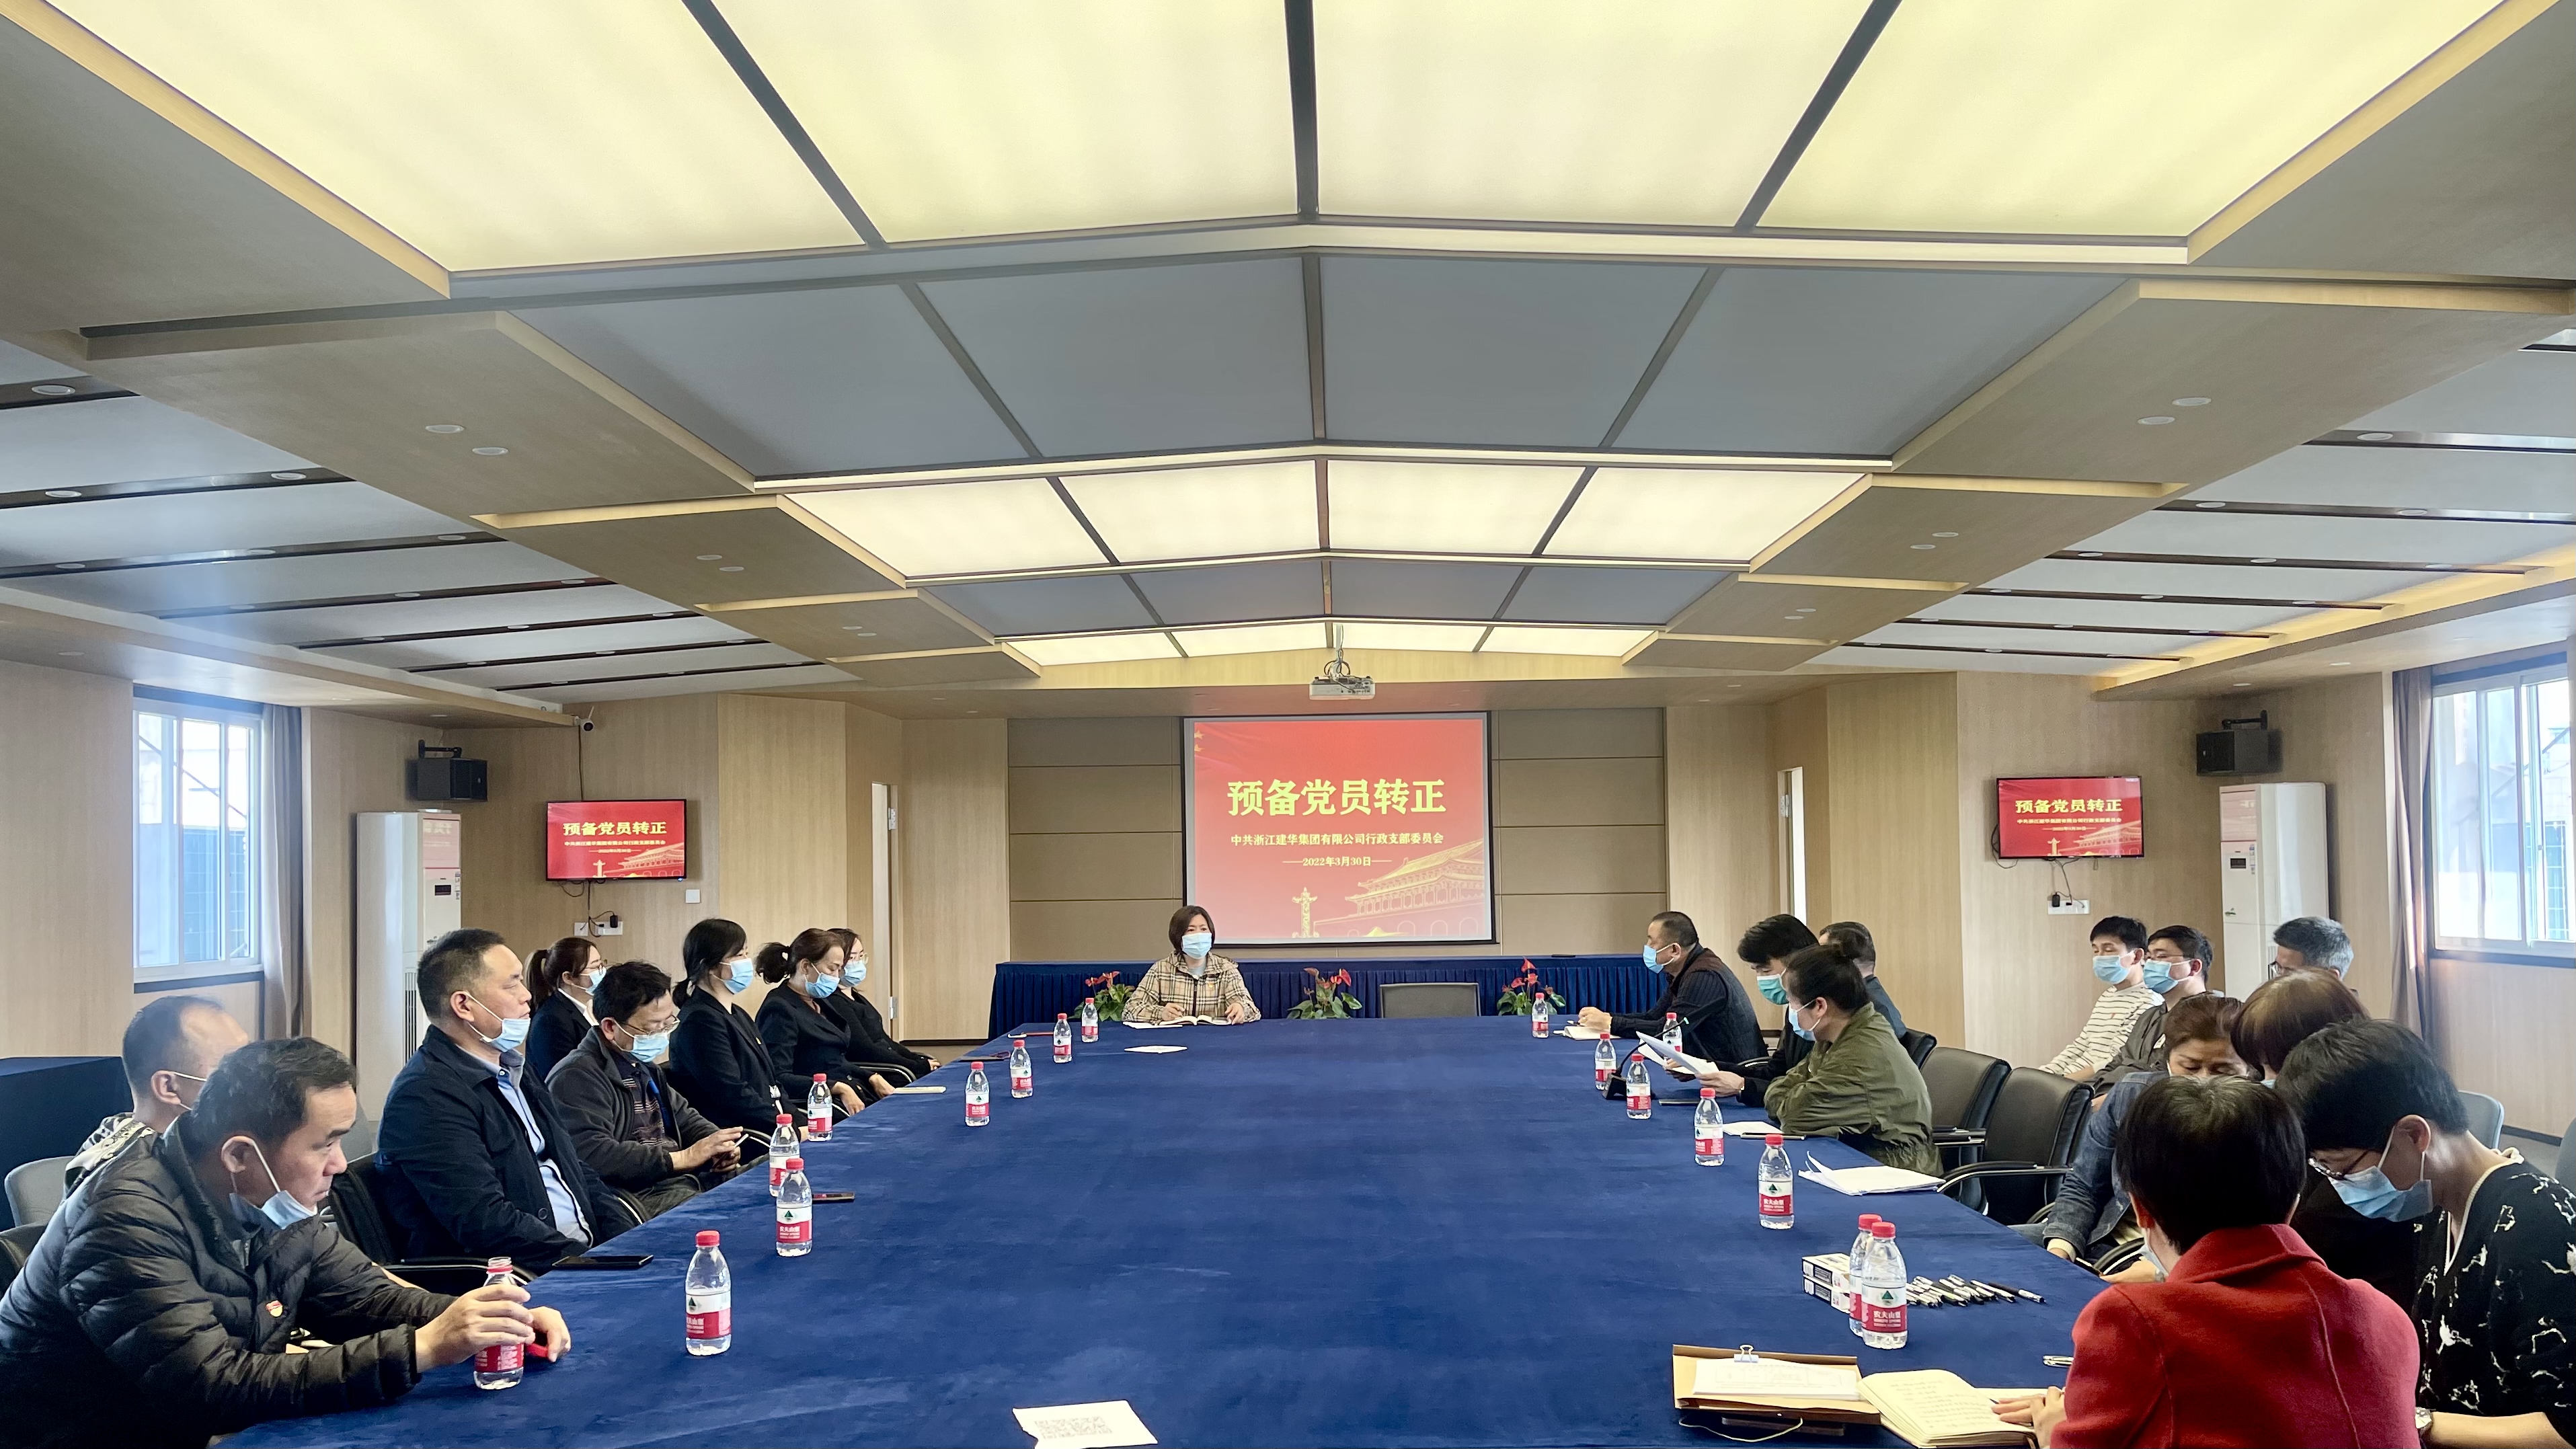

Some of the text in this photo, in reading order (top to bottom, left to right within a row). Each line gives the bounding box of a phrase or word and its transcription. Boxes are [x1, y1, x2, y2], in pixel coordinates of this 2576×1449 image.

[1227, 779, 1446, 816] 预备党员转正
[2015, 799, 2123, 814] 预备党员转正
[563, 821, 667, 836] 预备党员转正
[1231, 833, 1444, 846] 中共浙江建华集团有限公司行政支部委员会
